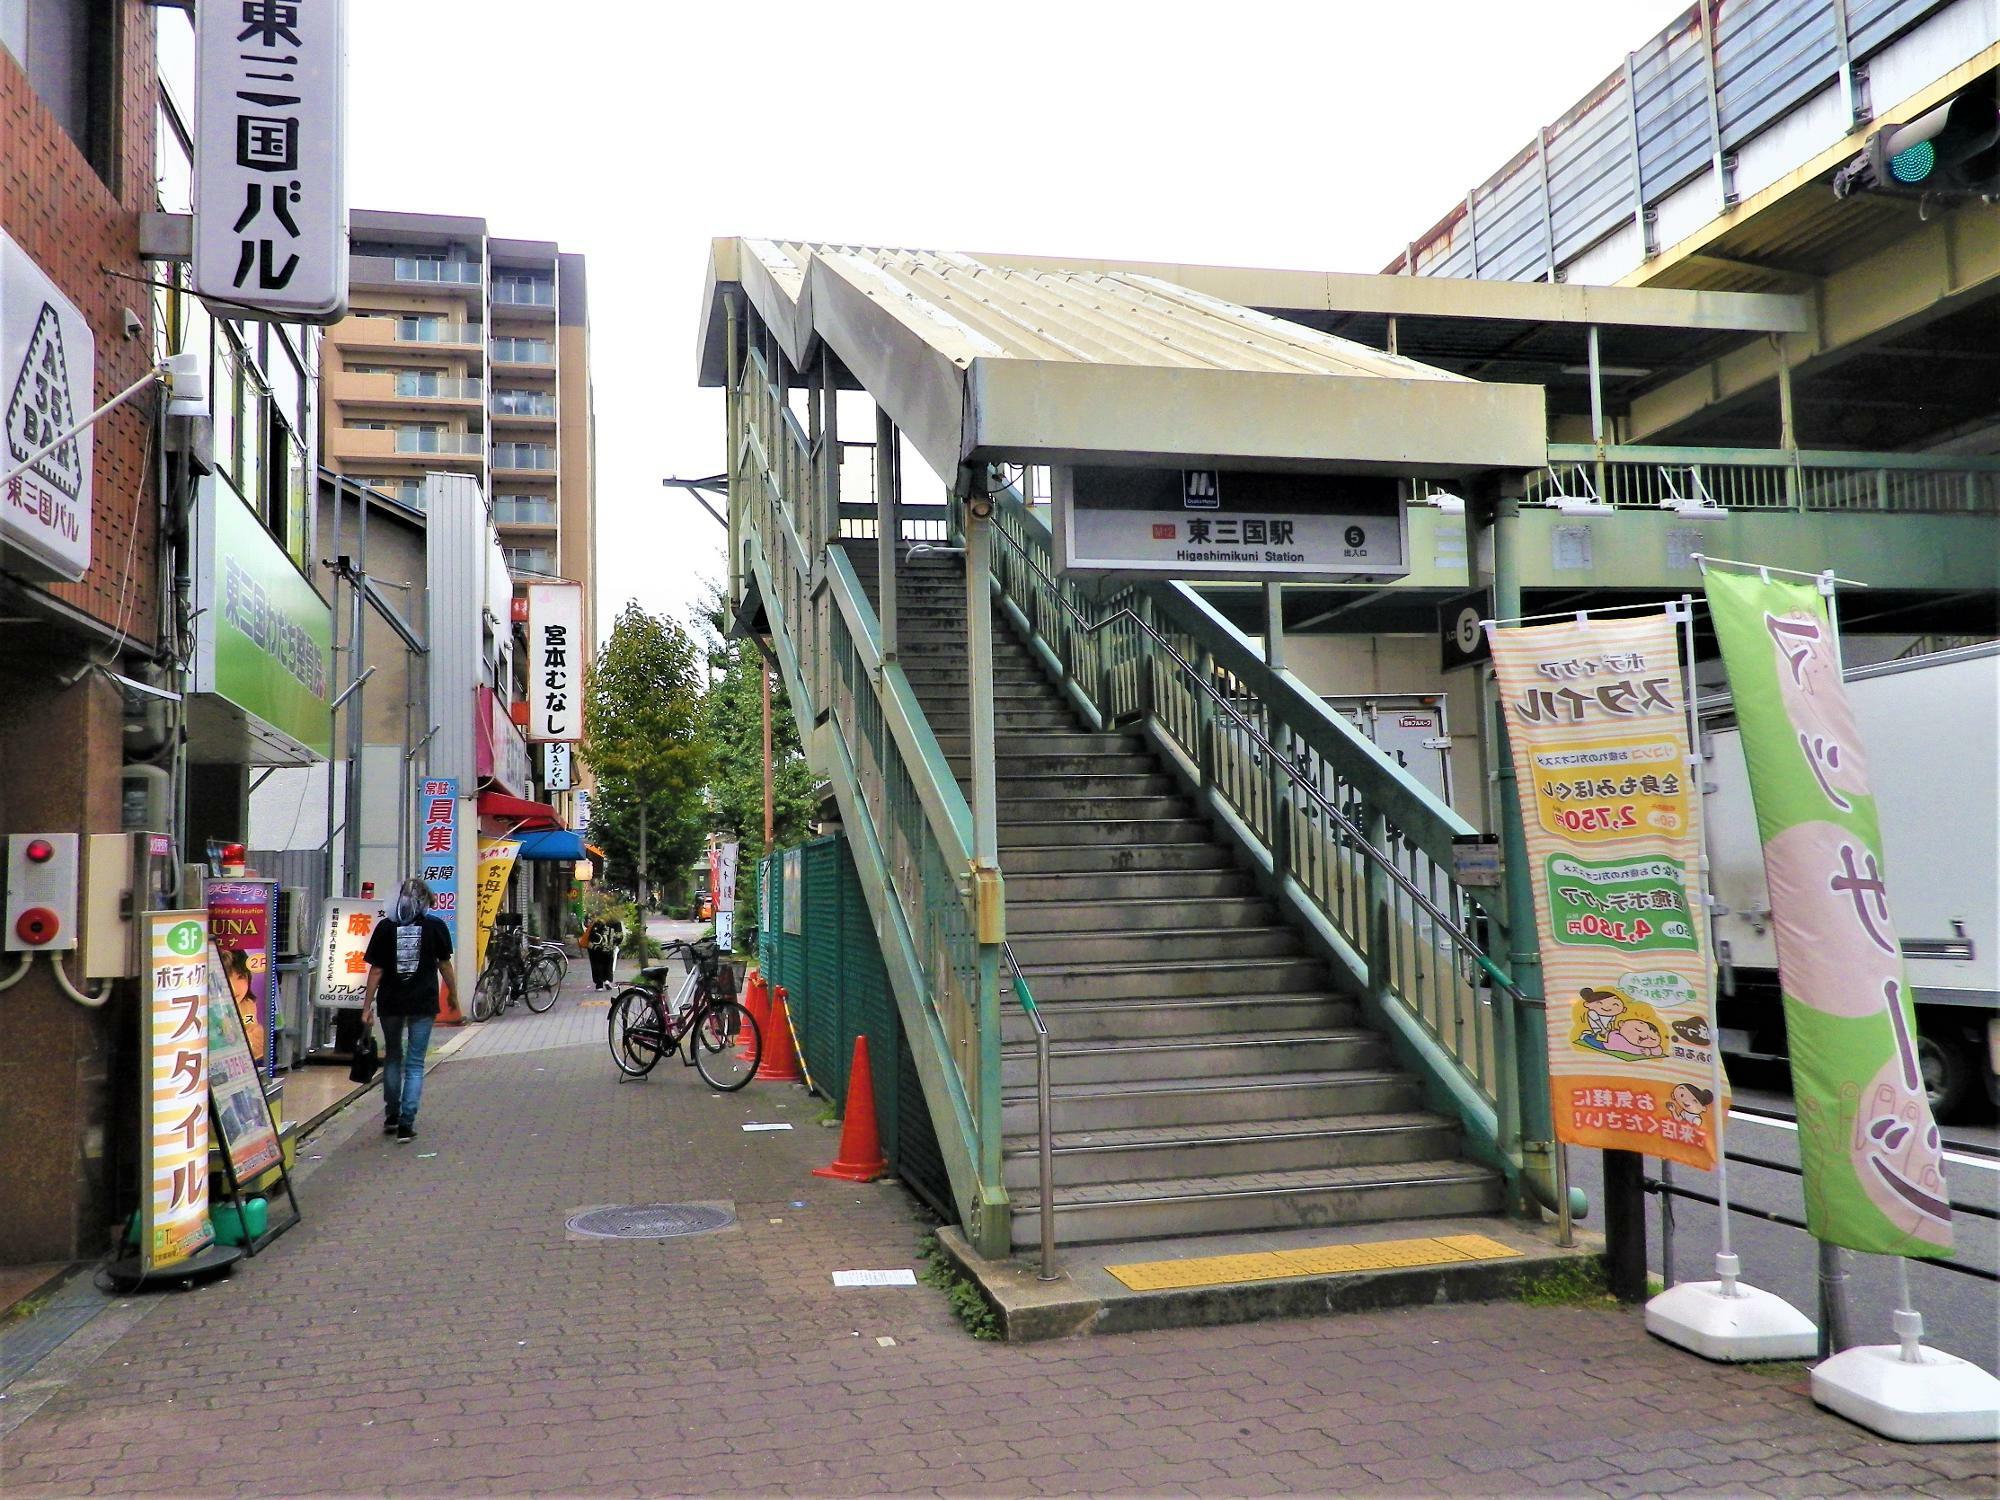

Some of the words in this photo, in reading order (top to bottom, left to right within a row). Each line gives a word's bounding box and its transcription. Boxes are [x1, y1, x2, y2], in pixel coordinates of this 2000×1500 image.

[233, 0, 303, 290] 東三国バル
[34, 371, 62, 427] 35
[24, 403, 70, 472] BAR
[8, 468, 79, 543] 東三国バル
[1187, 519, 1294, 546] 東三国駅
[1177, 550, 1259, 563] Higashimikuni
[1265, 552, 1304, 563] Station
[1344, 549, 1367, 558] 出入口
[1463, 618, 1473, 642] 5
[544, 624, 567, 735] 宮本むなし
[178, 926, 198, 950] 3F
[320, 993, 336, 1001] 080
[169, 994, 204, 1210] スタイル
